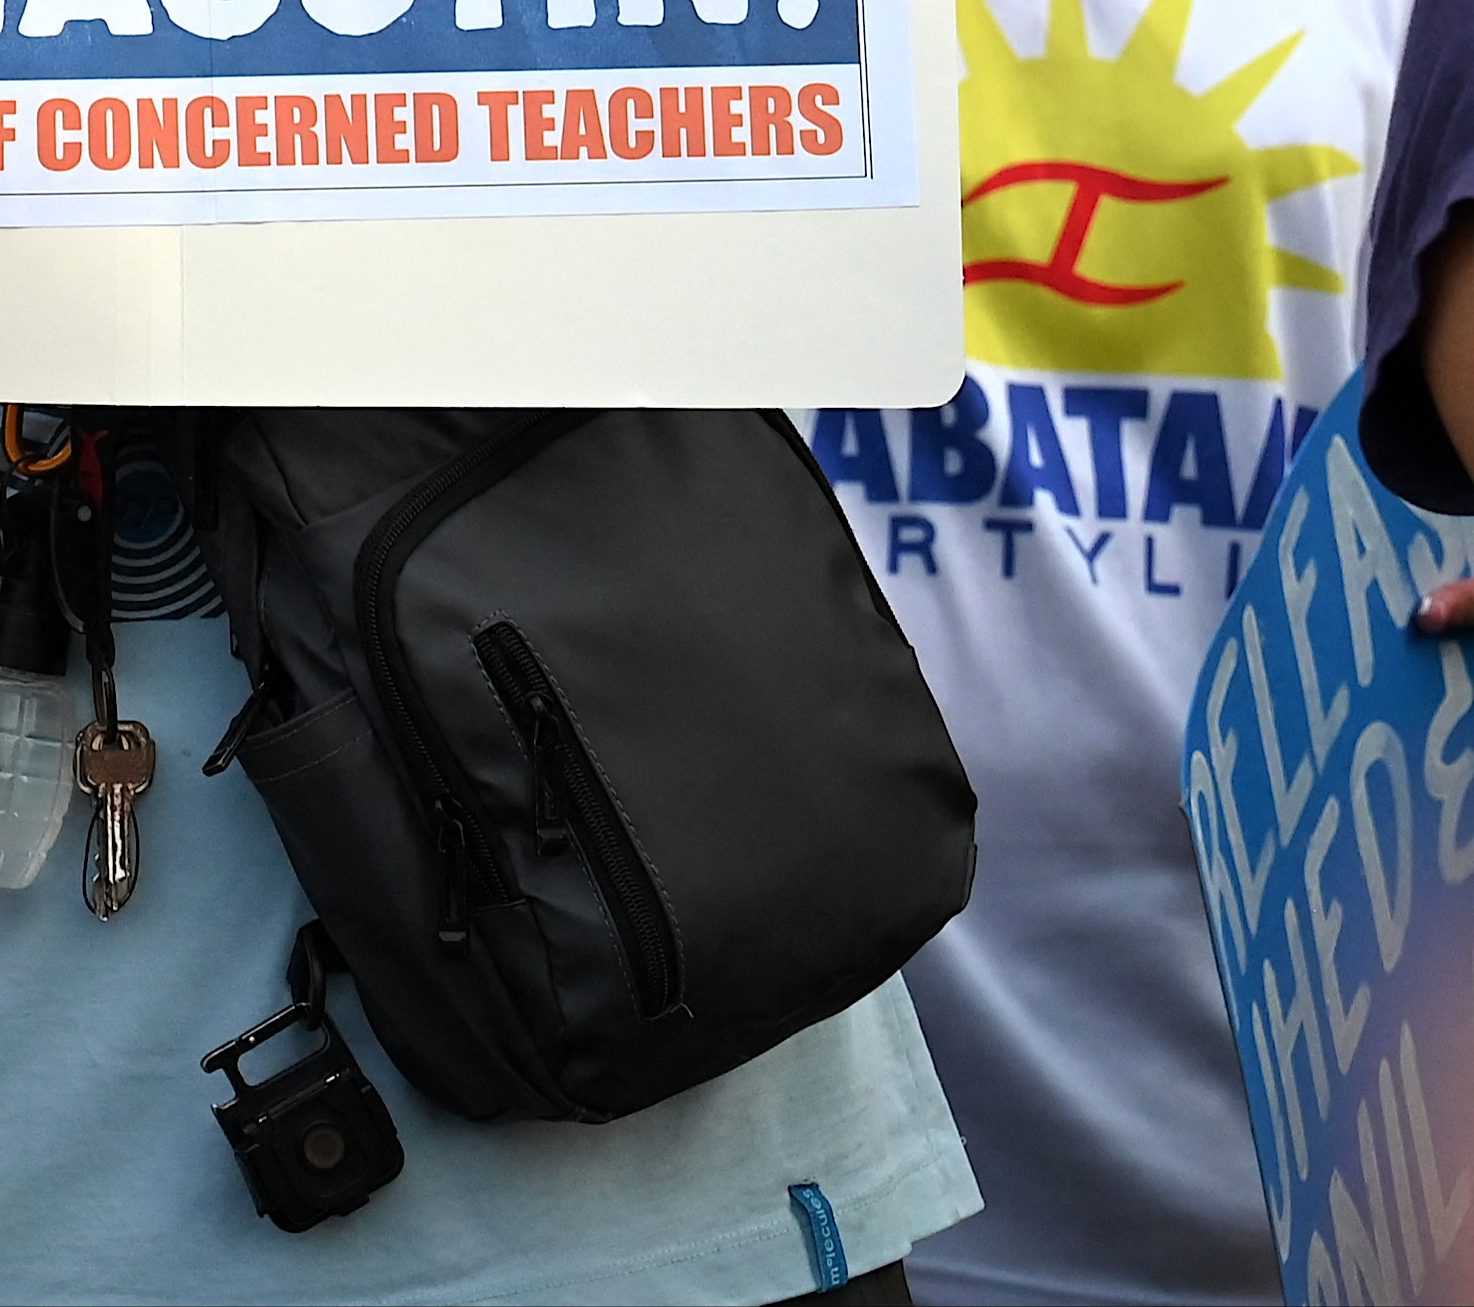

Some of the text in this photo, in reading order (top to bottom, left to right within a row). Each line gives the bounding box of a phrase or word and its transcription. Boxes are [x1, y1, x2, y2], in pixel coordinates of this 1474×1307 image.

[36, 92, 460, 172] CONCERNED
[478, 82, 844, 162] TEACHERS
[802, 1187, 840, 1286] molecules
